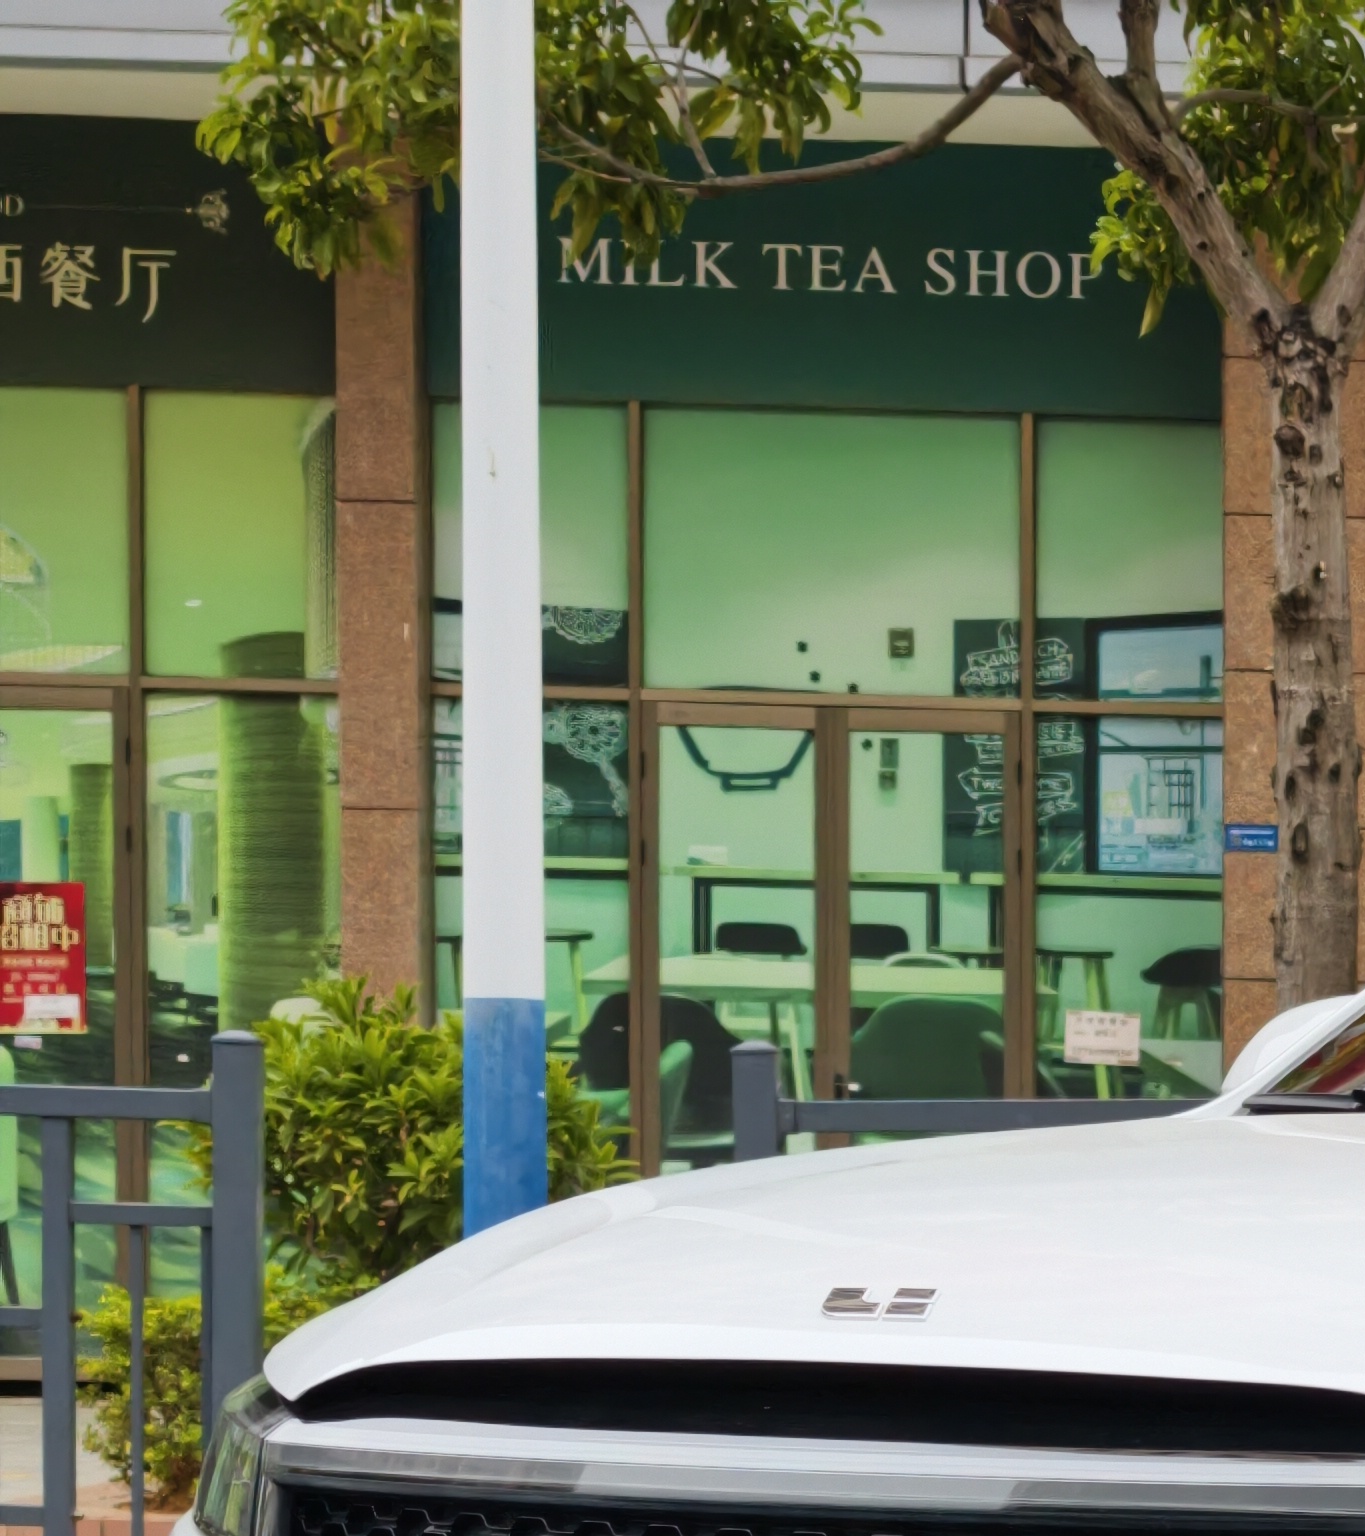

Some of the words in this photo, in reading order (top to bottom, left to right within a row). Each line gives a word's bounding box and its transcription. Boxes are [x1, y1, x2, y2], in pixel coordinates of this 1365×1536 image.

[557, 236, 739, 290] MILK
[762, 243, 898, 294] TEA
[924, 248, 1102, 300] SHOP
